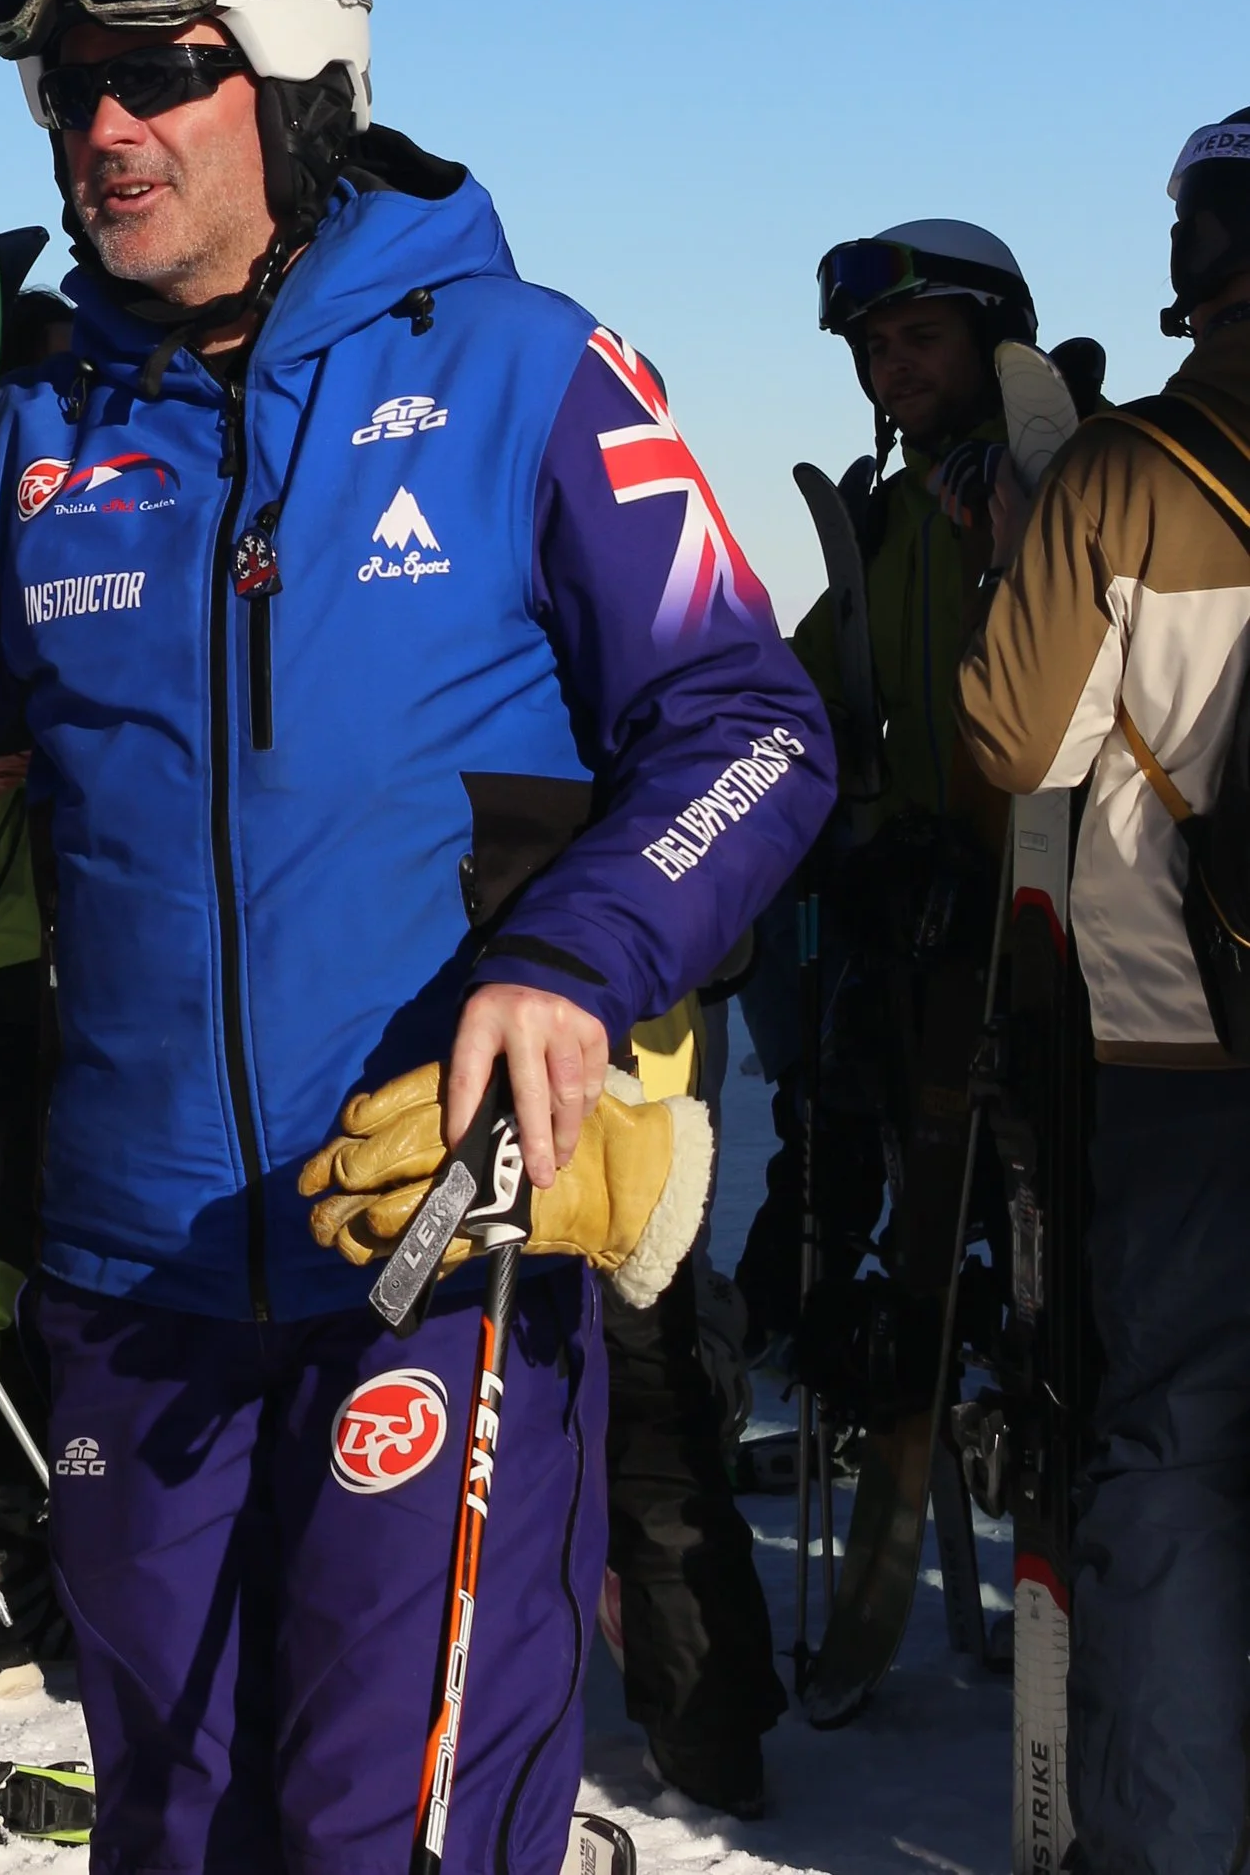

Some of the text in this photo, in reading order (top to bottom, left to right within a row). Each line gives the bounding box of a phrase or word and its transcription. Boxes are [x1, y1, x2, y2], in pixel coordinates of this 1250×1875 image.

[54, 498, 176, 515] British Ski Center
[24, 571, 146, 626] INSTRUCTOR
[358, 551, 451, 583] Rio Sport
[641, 798, 727, 882] ENGLISH
[403, 1198, 447, 1270] LEK
[55, 1459, 107, 1476] GSG
[465, 1369, 505, 1520] LEKI
[424, 1588, 475, 1861] FORCE
[1031, 1739, 1050, 1865] STRIKE
